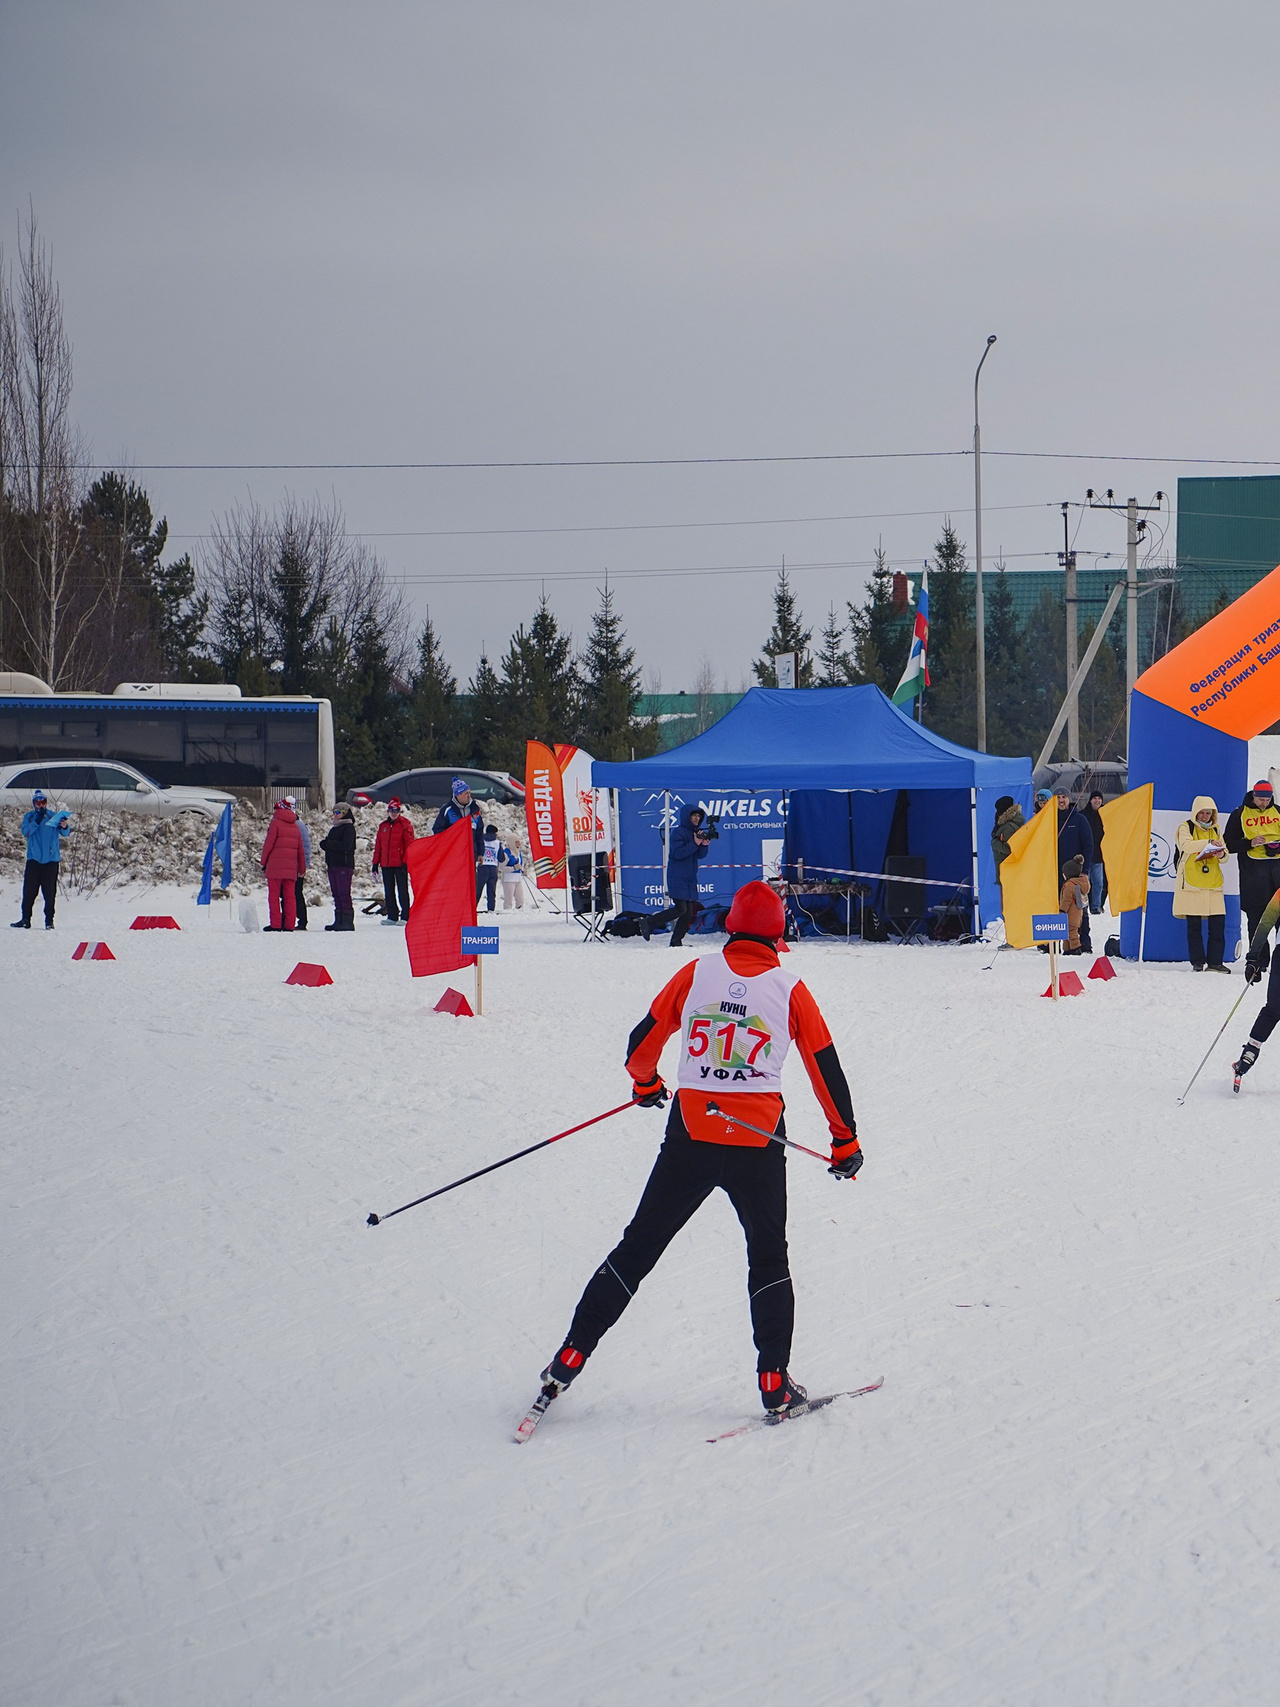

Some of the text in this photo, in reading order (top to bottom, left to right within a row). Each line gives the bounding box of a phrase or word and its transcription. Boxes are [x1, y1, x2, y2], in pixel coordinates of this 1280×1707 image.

[1189, 643, 1253, 694] Федерация
[1190, 663, 1259, 717] Республики
[533, 769, 554, 847] ПОБЕДА!
[698, 798, 772, 817] NIKELS
[571, 816, 590, 832] 80
[723, 822, 739, 830] СЕТЬ
[739, 822, 782, 830] СПОРТИВНЫХ
[1035, 923, 1066, 931] ФИНИШ
[462, 936, 498, 945] ТРАНЗИТ
[719, 1001, 747, 1017] КУНЦ
[688, 1018, 772, 1066] 517
[700, 1065, 748, 1081] УФА
